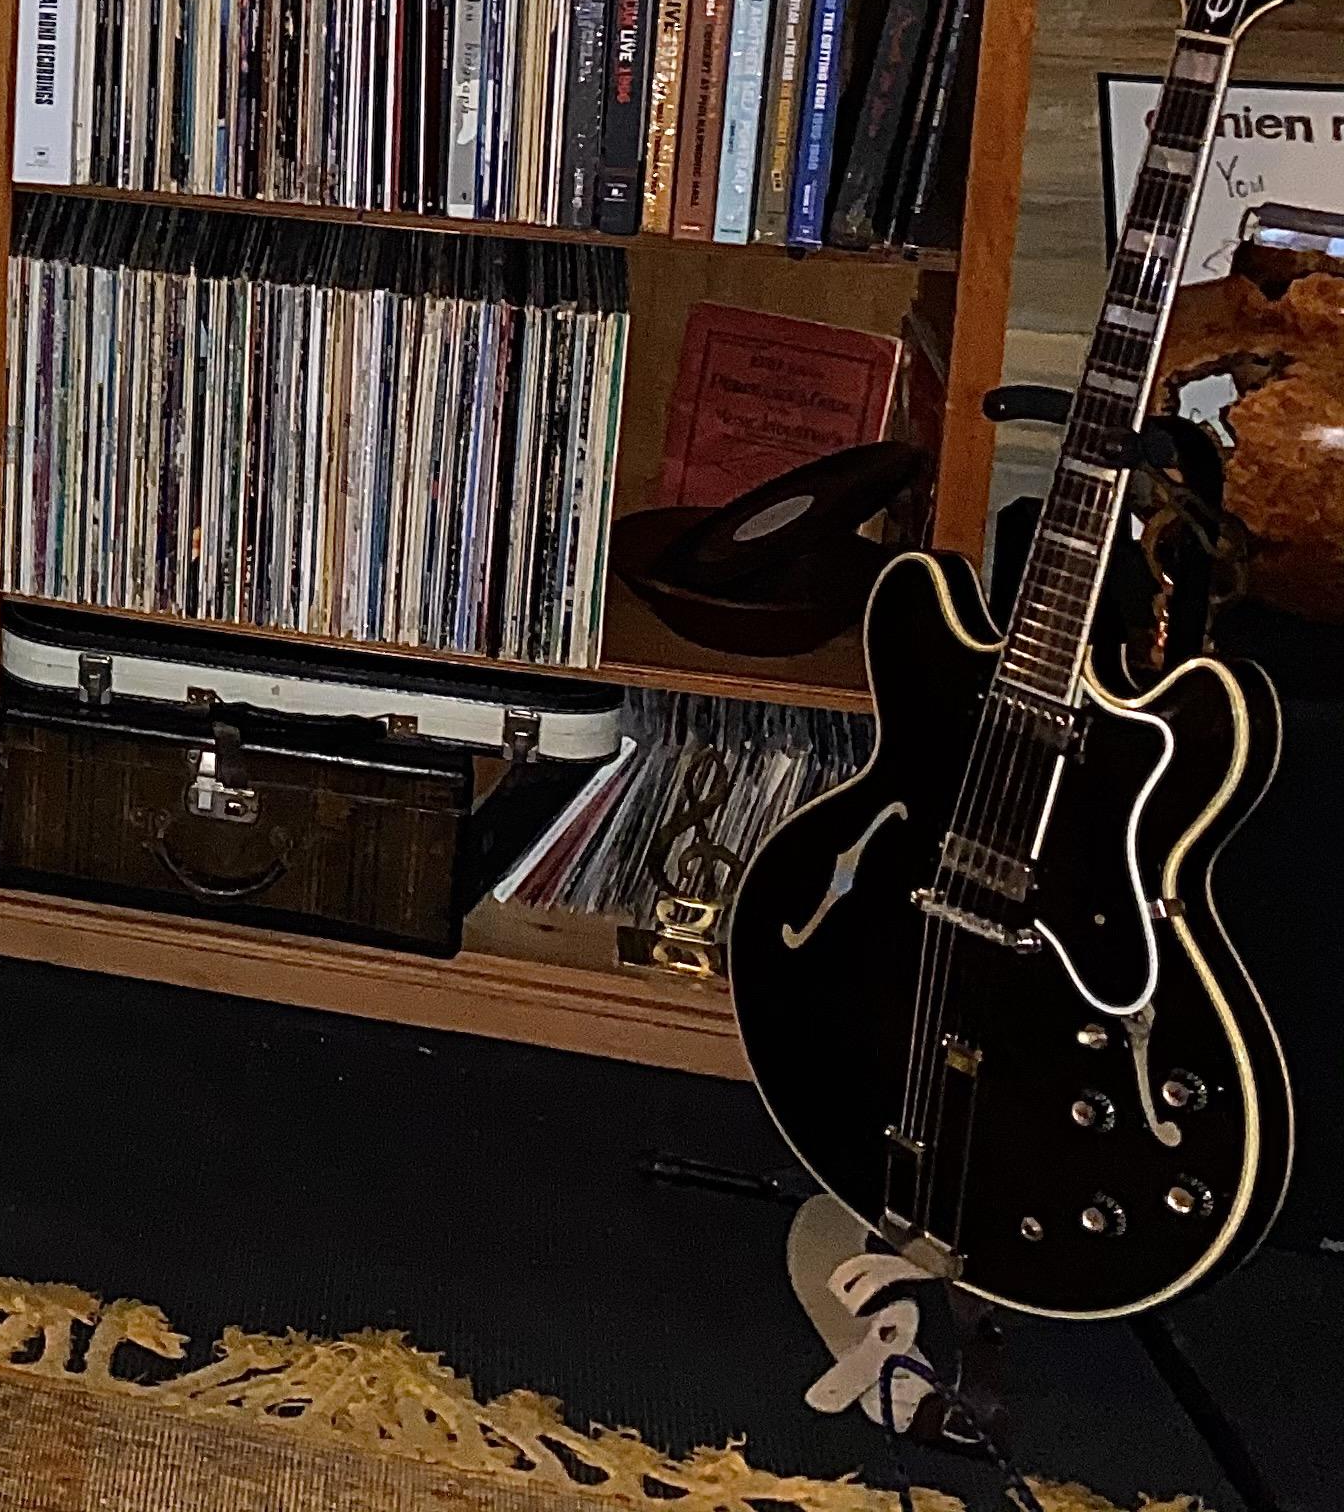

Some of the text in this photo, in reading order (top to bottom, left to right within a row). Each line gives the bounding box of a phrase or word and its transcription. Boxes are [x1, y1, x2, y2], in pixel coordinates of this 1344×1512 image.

[36, 12, 58, 41] MONO
[822, 12, 836, 31] THE
[619, 29, 636, 62] LIVE
[818, 33, 834, 81] CUTTING
[34, 44, 57, 106] RECORDINGS
[458, 43, 483, 114] biograph
[699, 78, 711, 92] AT
[813, 82, 828, 110] EDGE
